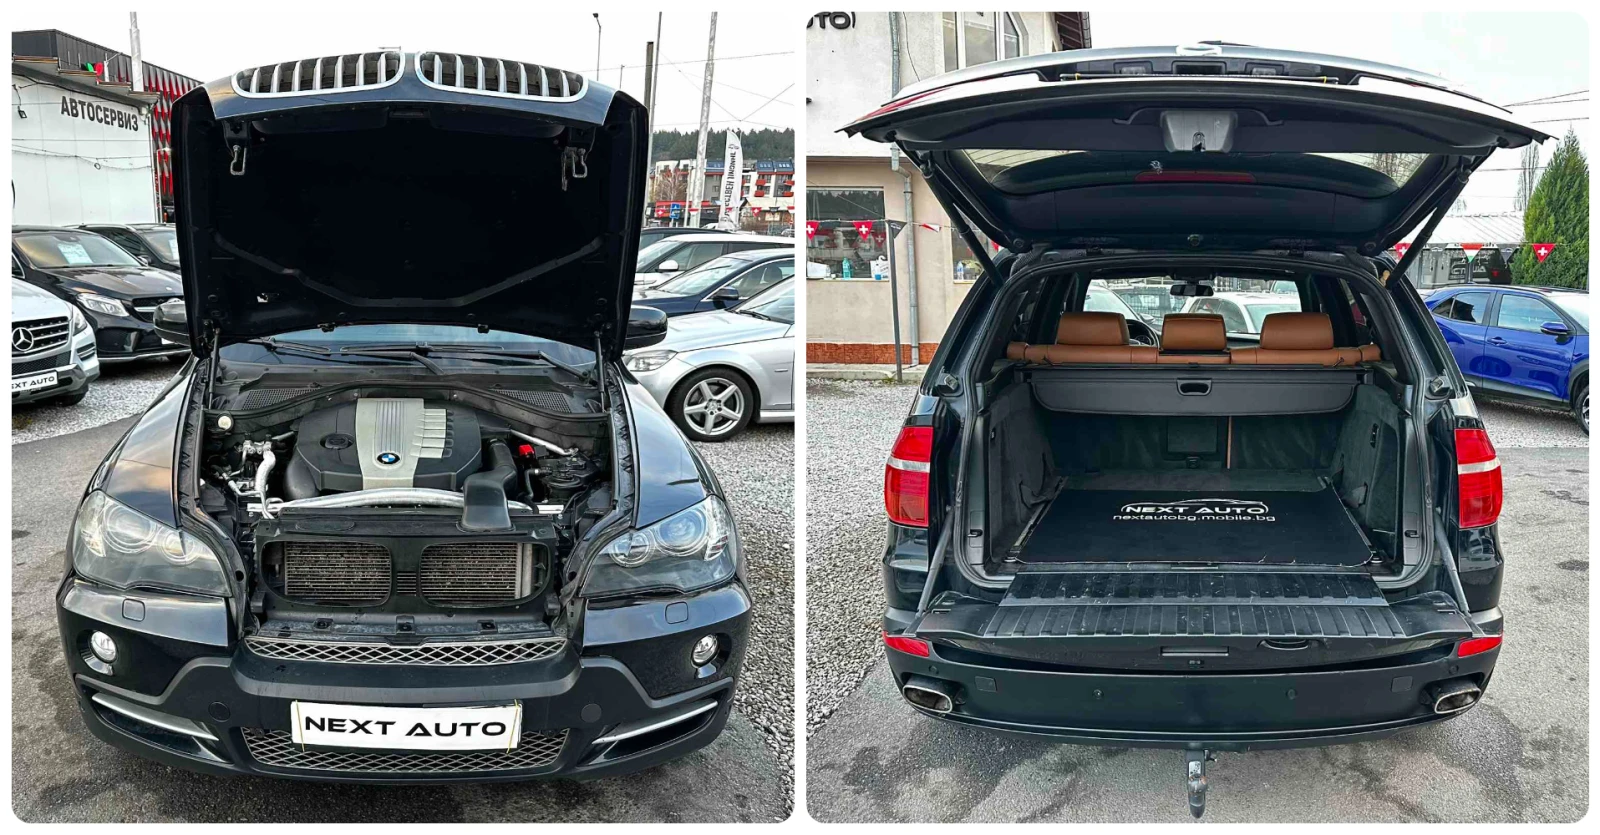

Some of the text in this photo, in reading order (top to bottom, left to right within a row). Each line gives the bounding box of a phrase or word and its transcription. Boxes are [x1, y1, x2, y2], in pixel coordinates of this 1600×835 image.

[60, 95, 139, 132] АВТОСЕРВИЗ
[30, 375, 55, 386] AUTO
[1126, 506, 1265, 514] NEXT AUTO
[1112, 514, 1276, 522] nextautobg.mobile.bg
[304, 716, 507, 737] NEXT AUTO
